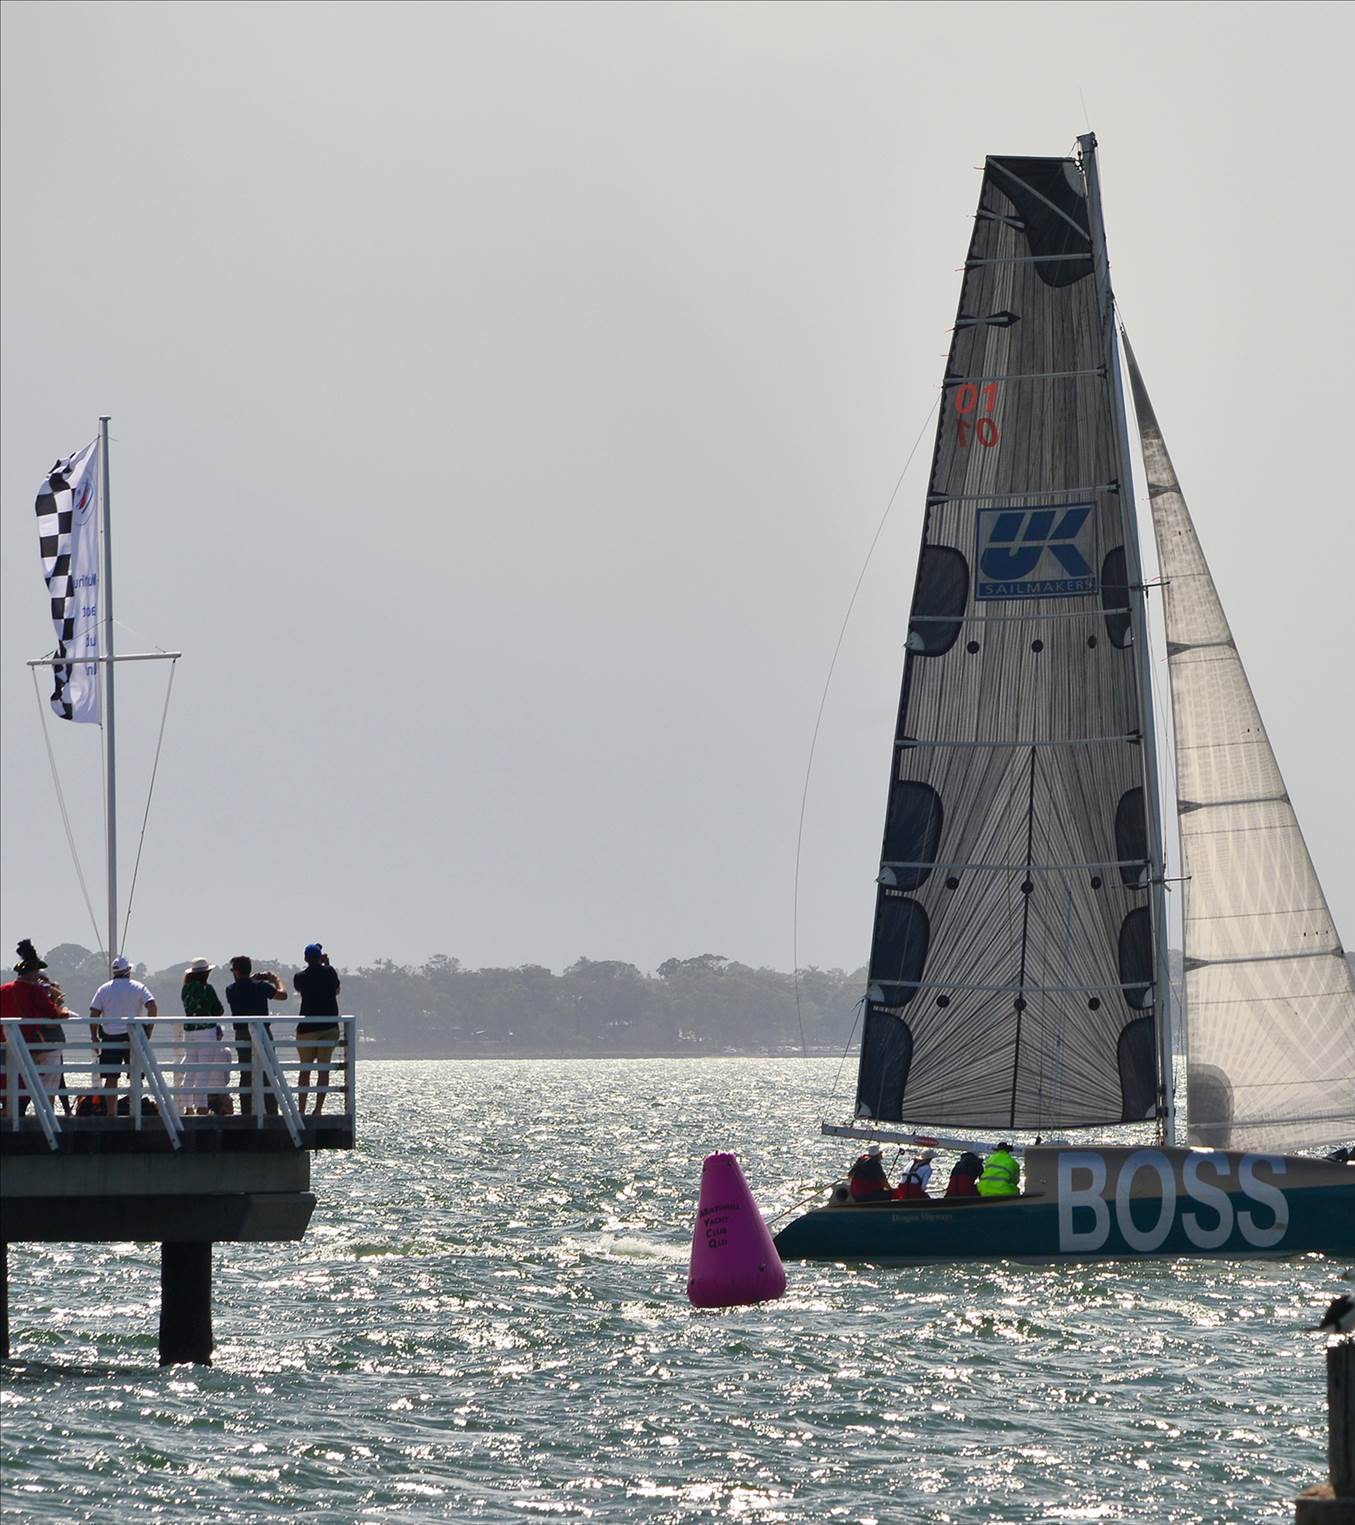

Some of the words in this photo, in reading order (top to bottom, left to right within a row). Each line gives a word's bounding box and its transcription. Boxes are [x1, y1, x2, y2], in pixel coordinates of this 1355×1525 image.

[955, 383, 999, 414] 01
[980, 508, 1094, 581] UK
[985, 579, 1095, 595] SAILMAKERS
[1058, 1150, 1290, 1252] BOSS
